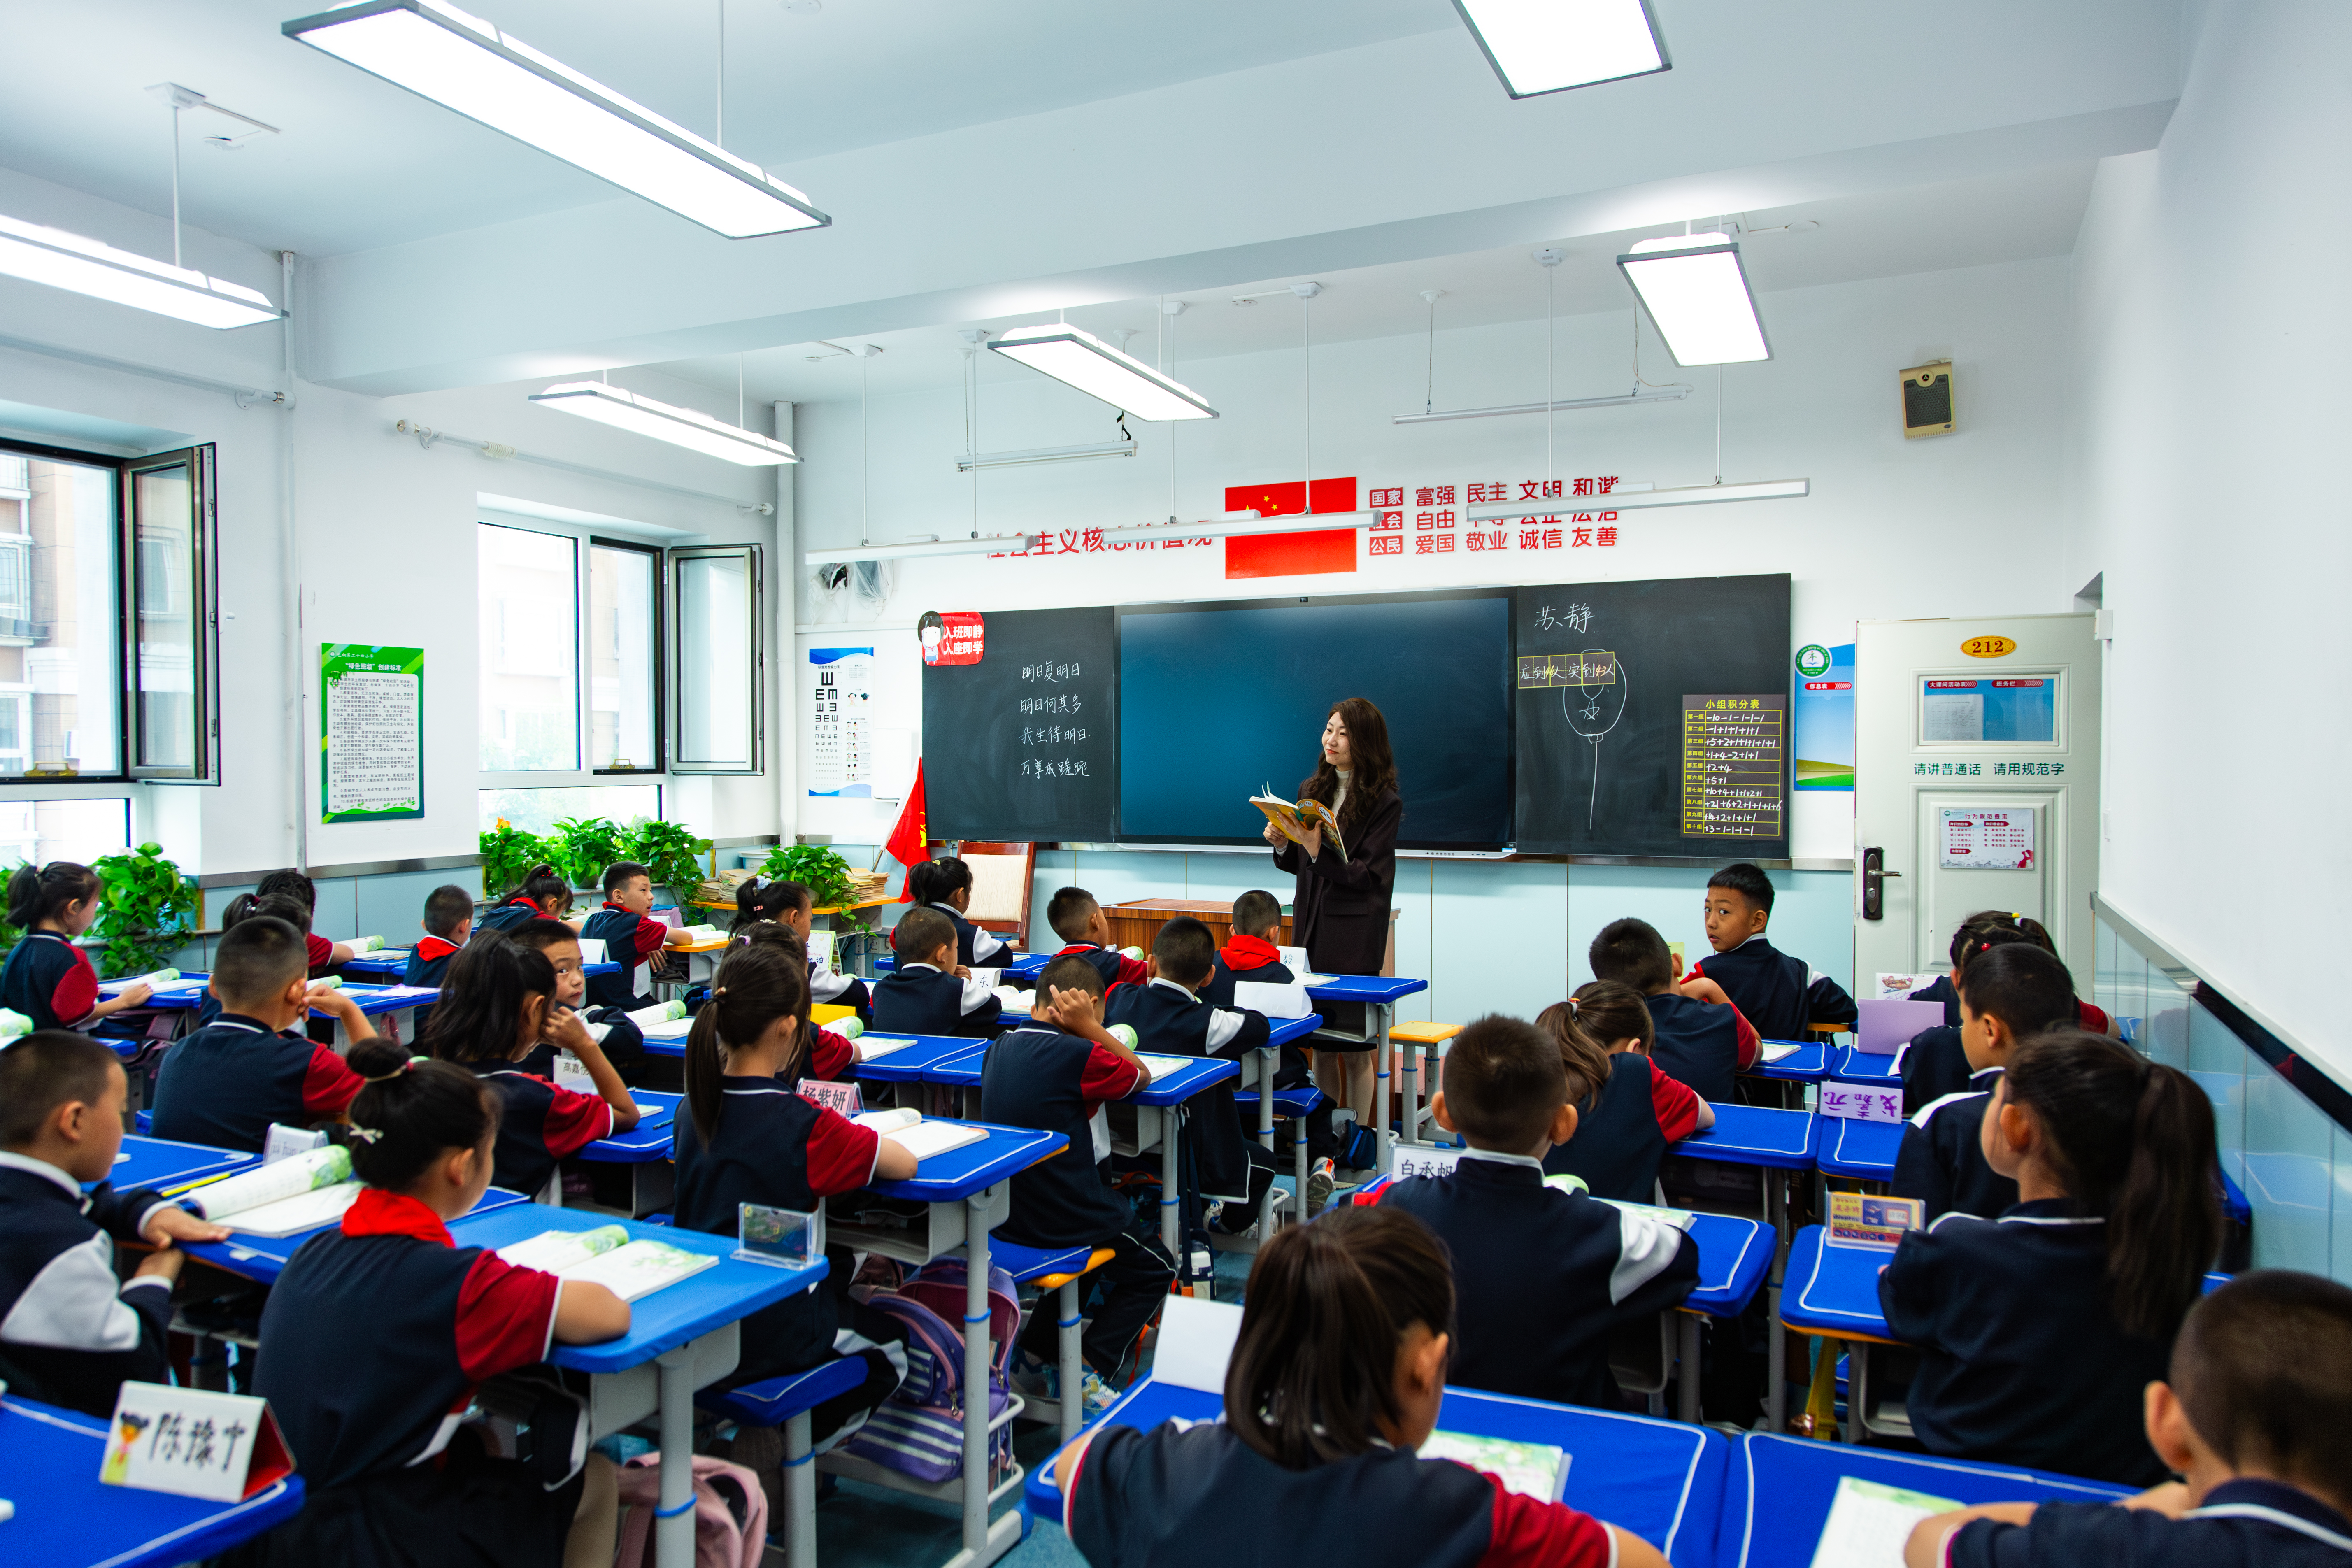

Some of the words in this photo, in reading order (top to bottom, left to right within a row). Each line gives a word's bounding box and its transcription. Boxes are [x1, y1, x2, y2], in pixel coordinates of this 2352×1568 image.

[1371, 489, 1401, 507] 国家
[1416, 486, 1456, 507] 富强
[1468, 482, 1508, 503] 民主
[1519, 480, 1562, 500] 文明
[1573, 476, 1618, 496] 和谐
[1417, 509, 1456, 530] 自由
[1371, 538, 1401, 554] 公民
[1416, 533, 1456, 554] 爱国
[1466, 531, 1508, 551] 敬业
[1519, 528, 1563, 550] 诚信
[1572, 526, 1618, 547] 友善
[1534, 603, 1595, 634] 苏静
[943, 624, 983, 639] 入班即静
[943, 641, 983, 655] 入座即学
[1973, 640, 2003, 653] 212
[1022, 661, 1080, 683] 明日复明日
[1020, 694, 1082, 715] 明日何其多
[1705, 699, 1760, 709] 小组积分表
[1019, 725, 1086, 746] 我生待明日
[1021, 758, 1090, 779] 万事成蹉跎
[1706, 763, 1732, 773] +2+4
[1914, 763, 1981, 776] 请讲普通话
[1994, 763, 2064, 775] 请用规范字
[1705, 776, 1727, 784] +5+1
[979, 975, 988, 988] 东
